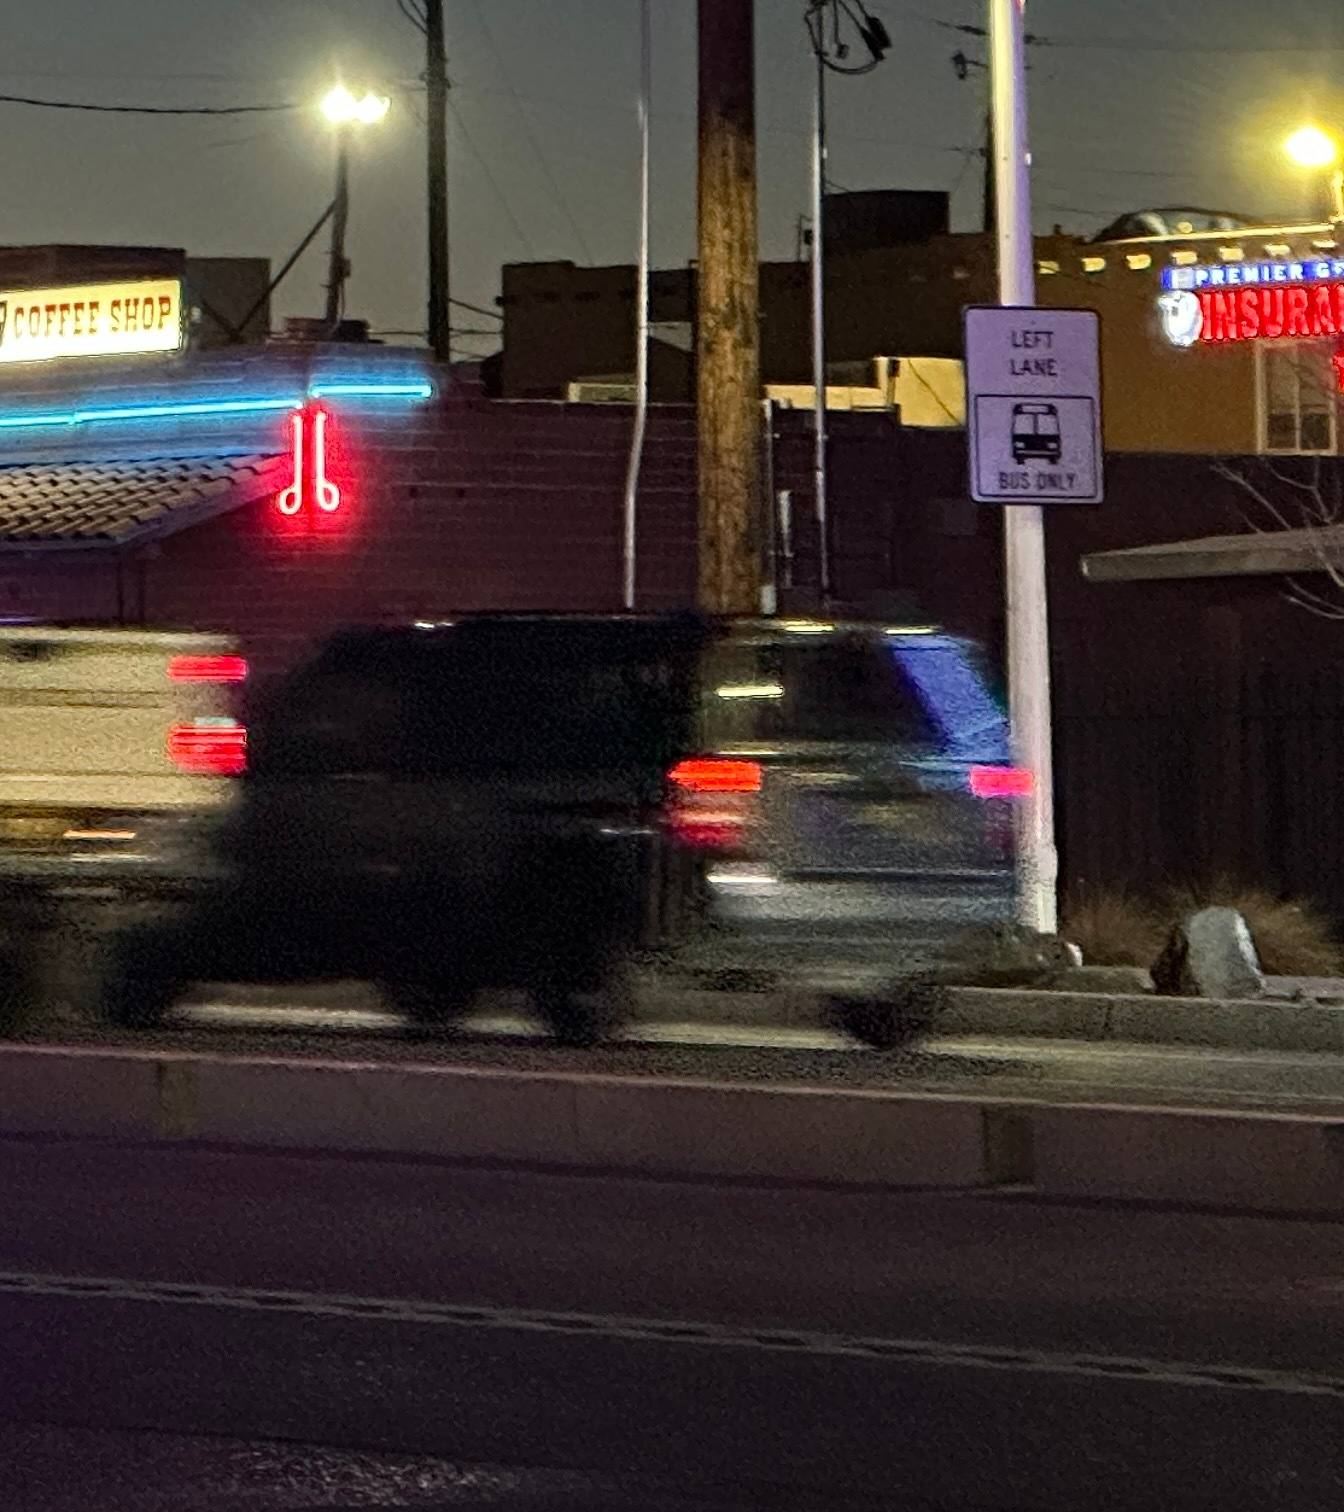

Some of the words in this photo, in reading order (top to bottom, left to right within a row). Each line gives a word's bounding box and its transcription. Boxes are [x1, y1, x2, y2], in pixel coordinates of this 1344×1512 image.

[1195, 264, 1305, 287] PREMIER
[14, 301, 100, 339] COFFEE
[111, 296, 172, 332] SHOP
[1012, 331, 1054, 349] LEFT
[1011, 359, 1057, 376] LANE
[999, 472, 1031, 489] BUS
[1037, 473, 1076, 490] ONLY
